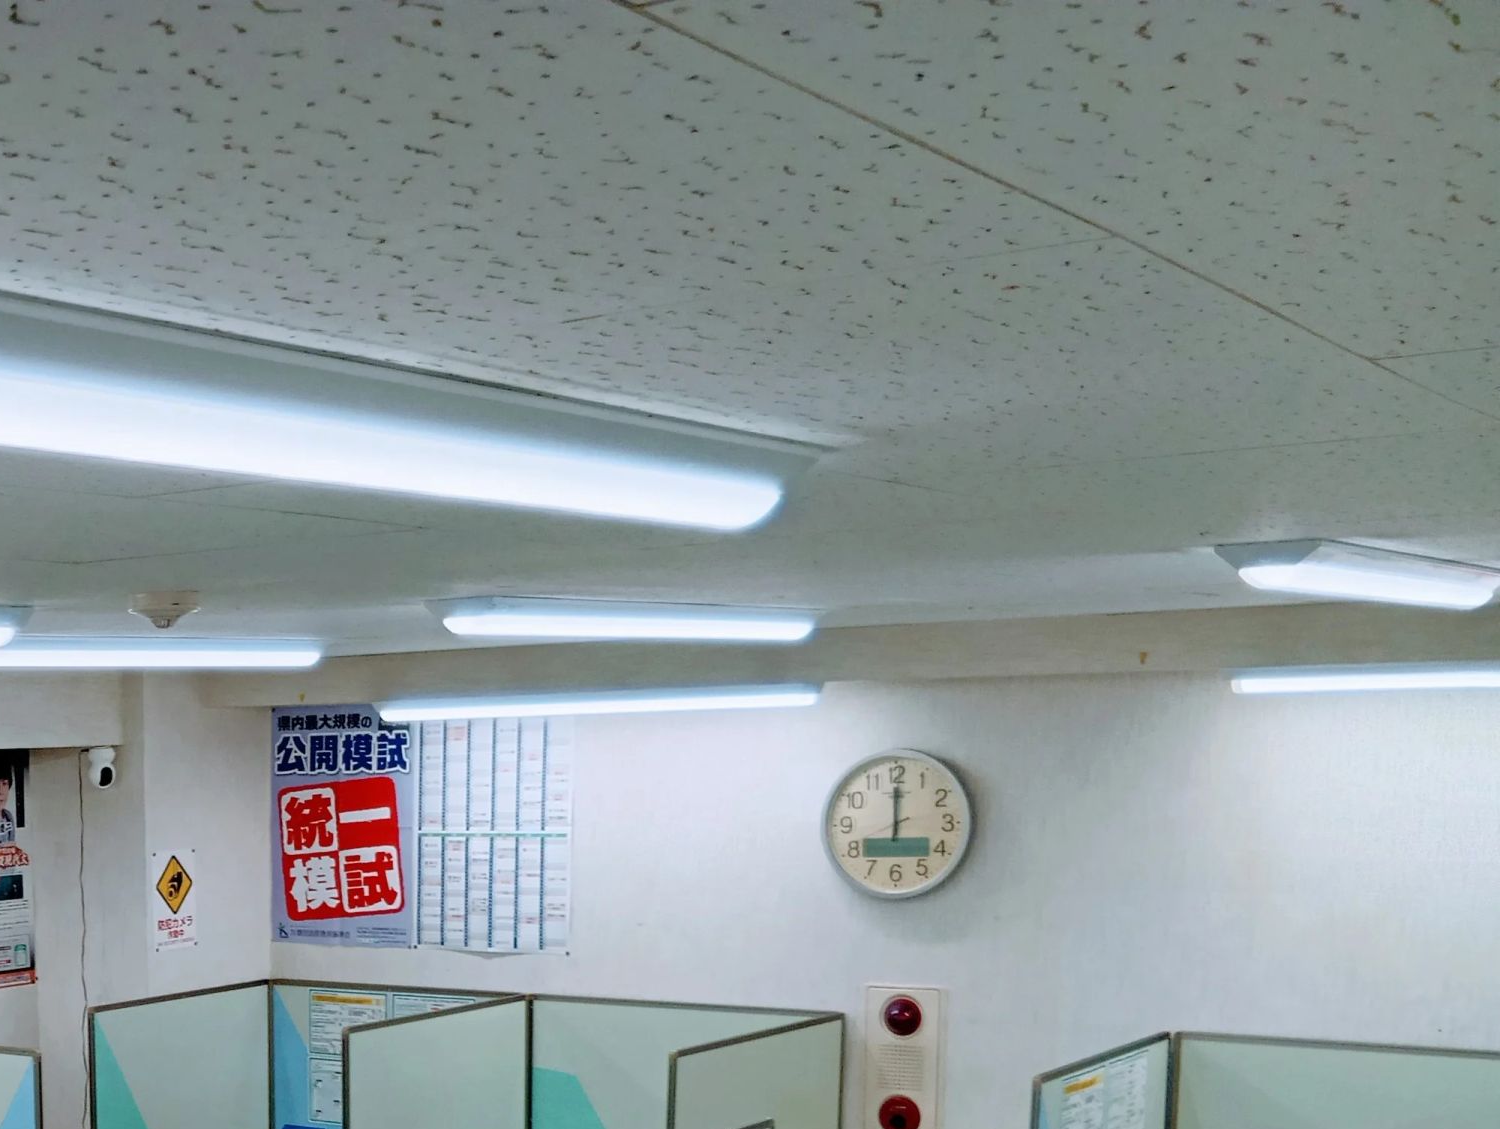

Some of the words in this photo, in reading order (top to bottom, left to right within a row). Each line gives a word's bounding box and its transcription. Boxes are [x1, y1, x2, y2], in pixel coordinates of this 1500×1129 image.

[277, 713, 373, 732] 県内最大規模の
[276, 731, 409, 773] 公開模試
[865, 773, 880, 791] 11
[888, 765, 906, 784] 12
[919, 771, 926, 790] 1
[845, 791, 864, 810] 10
[935, 788, 948, 808] 2
[284, 793, 392, 851] 統一
[839, 815, 853, 834] 9
[940, 813, 955, 833] 3
[846, 840, 860, 859] 8
[932, 839, 947, 857] 4
[865, 859, 878, 877] 7
[888, 864, 903, 882] 6
[915, 858, 929, 877] 5
[289, 851, 399, 913] 模試
